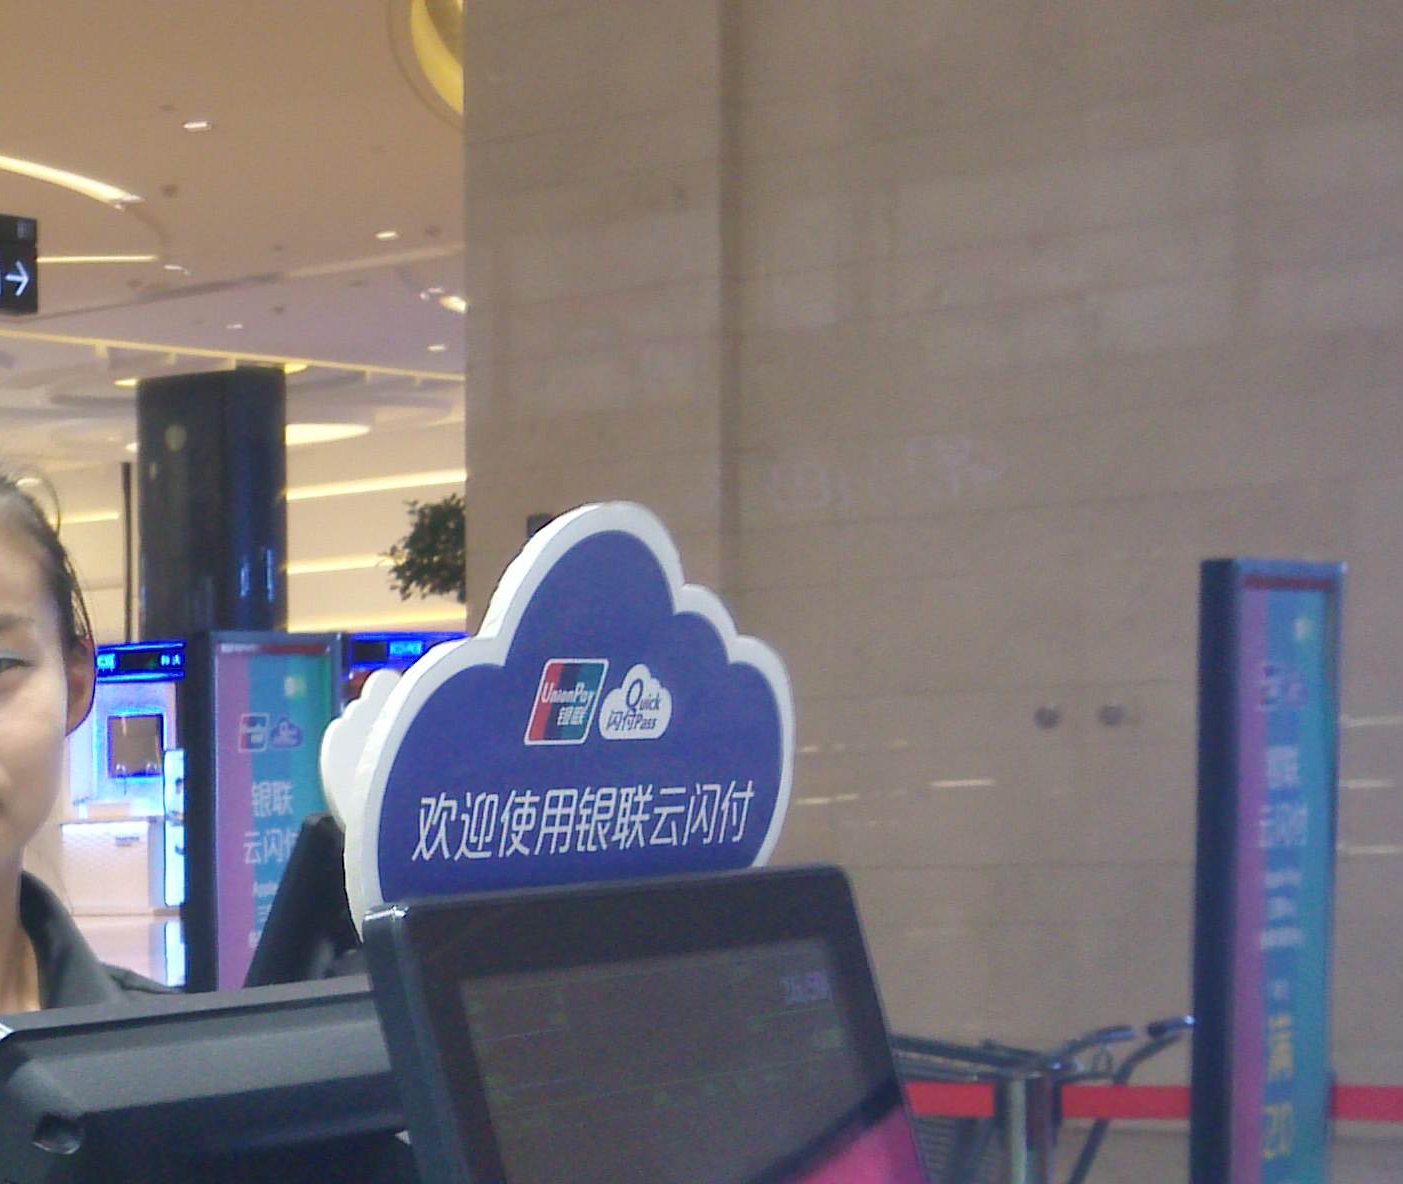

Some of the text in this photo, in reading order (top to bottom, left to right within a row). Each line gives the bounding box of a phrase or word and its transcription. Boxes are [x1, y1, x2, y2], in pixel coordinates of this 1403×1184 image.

[541, 681, 595, 712] UnionPay
[606, 711, 657, 731] 闪付 Pass
[251, 781, 294, 817] 银联
[411, 779, 756, 862] 欢迎使用银联云闪付
